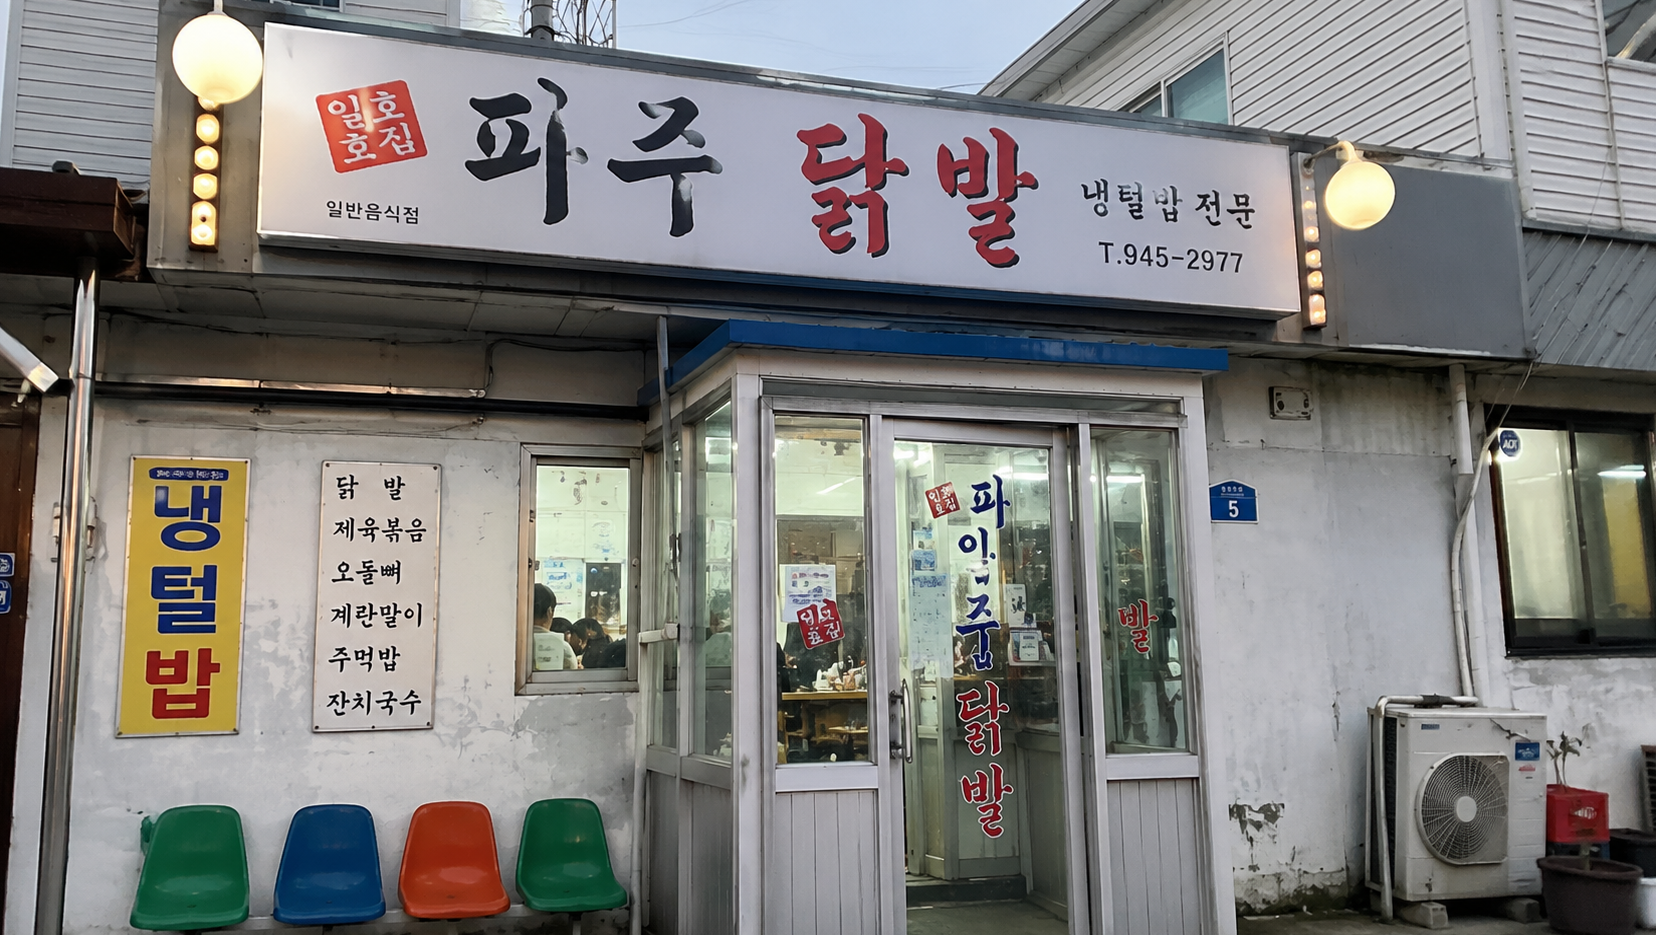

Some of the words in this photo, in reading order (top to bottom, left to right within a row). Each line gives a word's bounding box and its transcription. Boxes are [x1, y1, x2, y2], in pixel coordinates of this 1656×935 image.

[465, 77, 724, 238] 파주
[797, 113, 1039, 268] 닭발
[326, 200, 419, 225] 일반음식점
[1081, 179, 1183, 223] 냉털밥
[1195, 190, 1256, 230] 전문
[1098, 241, 1243, 273] T.945-2977
[1228, 500, 1240, 518] 5
[333, 516, 427, 543] 제육볶음
[331, 559, 402, 586] 오돌뼈
[145, 485, 222, 720] 냉털밥
[330, 602, 423, 629] 계란말이
[1118, 599, 1159, 654] 발
[328, 645, 401, 673] 주먹밥
[326, 689, 422, 717] 잔치국수
[956, 680, 1014, 839] 닭발
